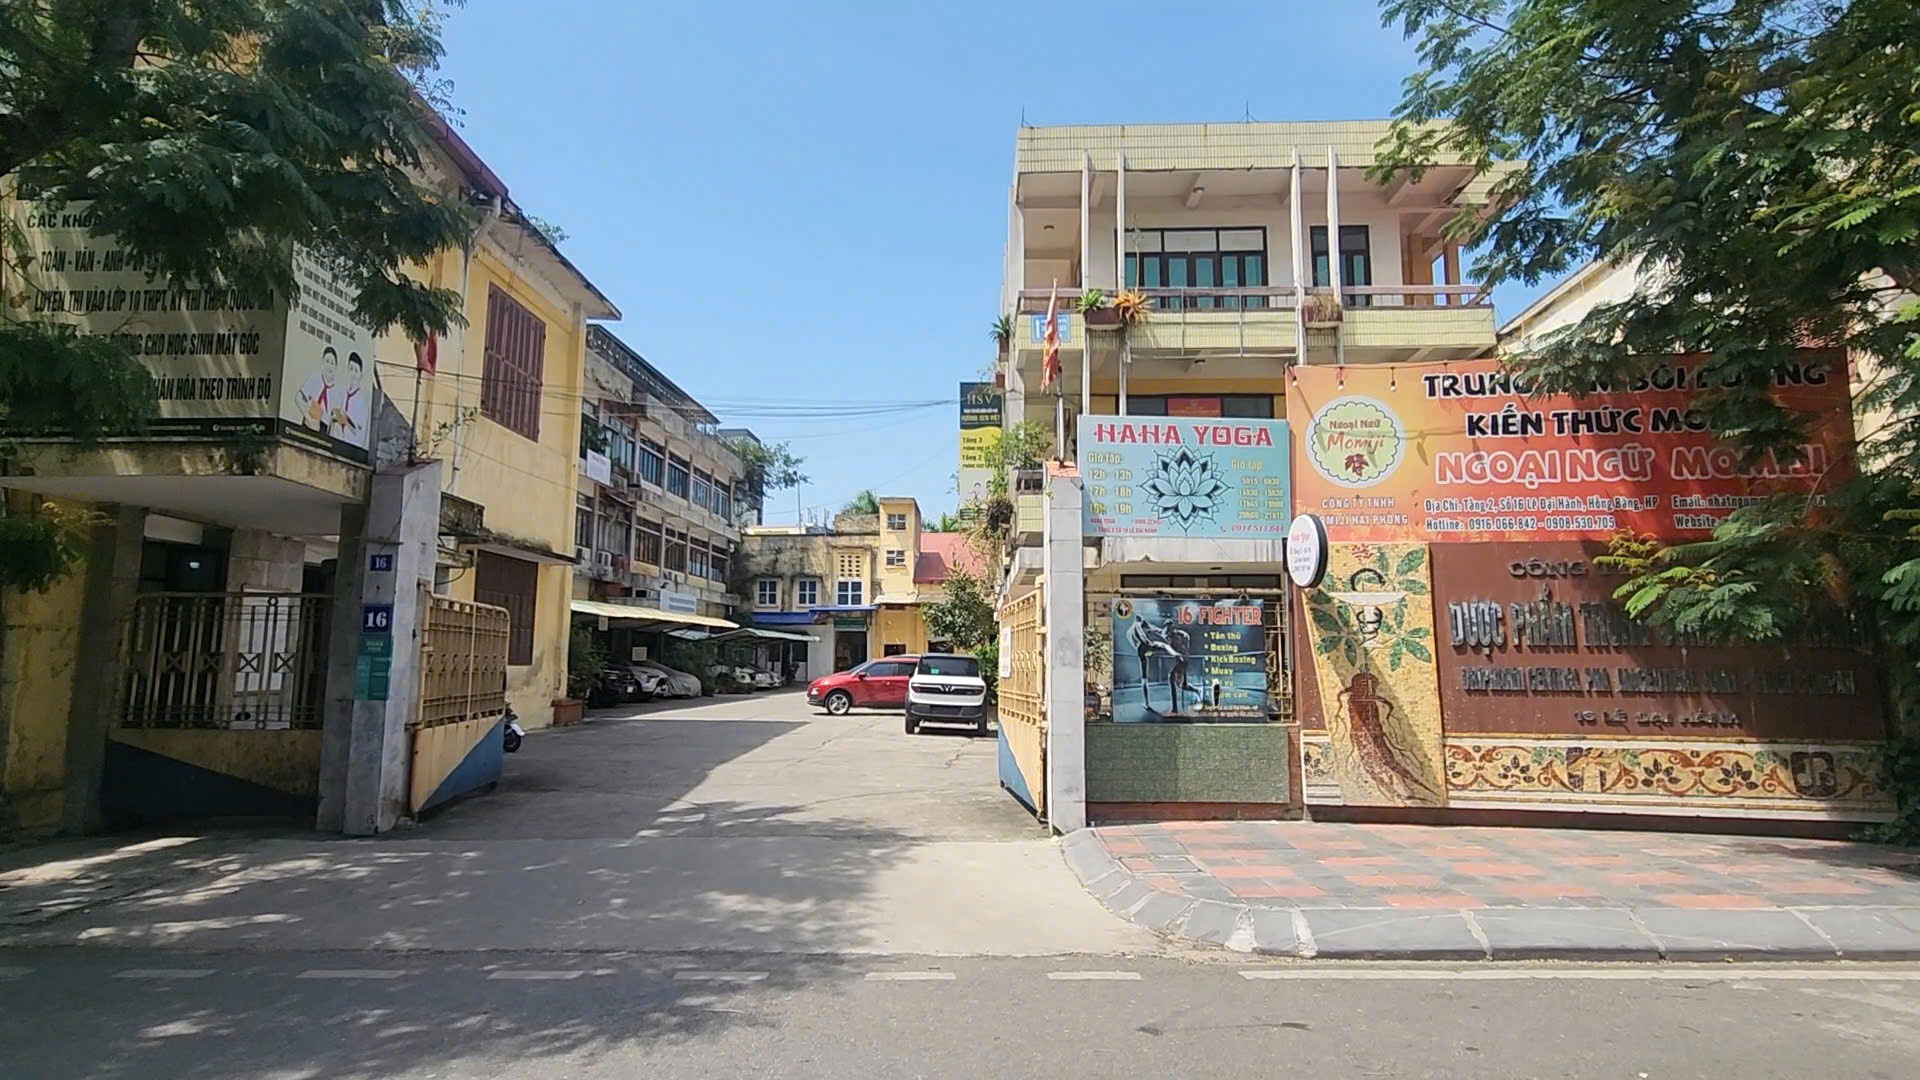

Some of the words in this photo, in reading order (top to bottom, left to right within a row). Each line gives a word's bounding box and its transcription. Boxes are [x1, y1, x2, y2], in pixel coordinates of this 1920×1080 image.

[35, 286, 65, 317] LUYỆN
[68, 290, 83, 311] THI
[86, 286, 104, 311] VÀO
[129, 290, 141, 311] 10
[144, 334, 164, 355] CHO
[167, 334, 187, 360] HỌC
[189, 333, 213, 355] SINH
[239, 327, 260, 355] GỐC
[177, 374, 195, 401] HÓA
[199, 378, 223, 400] THEO
[226, 373, 256, 400] TRÌNH
[1467, 404, 1544, 436] KIẾN
[1552, 406, 1642, 434] THỨC
[1094, 423, 1182, 444] HAHA
[1192, 425, 1273, 446] YOGA
[1327, 431, 1385, 455] Momiji
[1115, 469, 1132, 481] 13h
[1437, 452, 1559, 487] NGOẠI
[1567, 445, 1655, 482] NGỮ
[1367, 497, 1394, 508] TNHH
[1425, 499, 1441, 512] Địa
[1464, 498, 1486, 512] Tầng
[1500, 497, 1512, 511] Số
[1513, 499, 1523, 510] 16
[1527, 498, 1537, 511] Lê
[1540, 498, 1555, 512] Đại
[1559, 496, 1586, 511] Hành,
[1645, 496, 1658, 508] HP
[1426, 518, 1464, 531] Hotline:
[1469, 517, 1536, 531] 0916.066.842
[1546, 516, 1616, 530] 0908.530.705
[375, 556, 388, 569] 16
[1508, 557, 1587, 577] CÔNG
[365, 611, 388, 628] 16
[1177, 606, 1193, 624] 16
[1199, 606, 1262, 625] FIGHTER
[1448, 600, 1506, 655] DƯỢC
[1510, 584, 1577, 648] PHẨM
[1210, 643, 1239, 653] Boxing
[1210, 655, 1257, 665] KickBoxing
[1210, 667, 1234, 676] Muay
[1574, 709, 1598, 725] 16
[1603, 708, 1628, 726] LÊ
